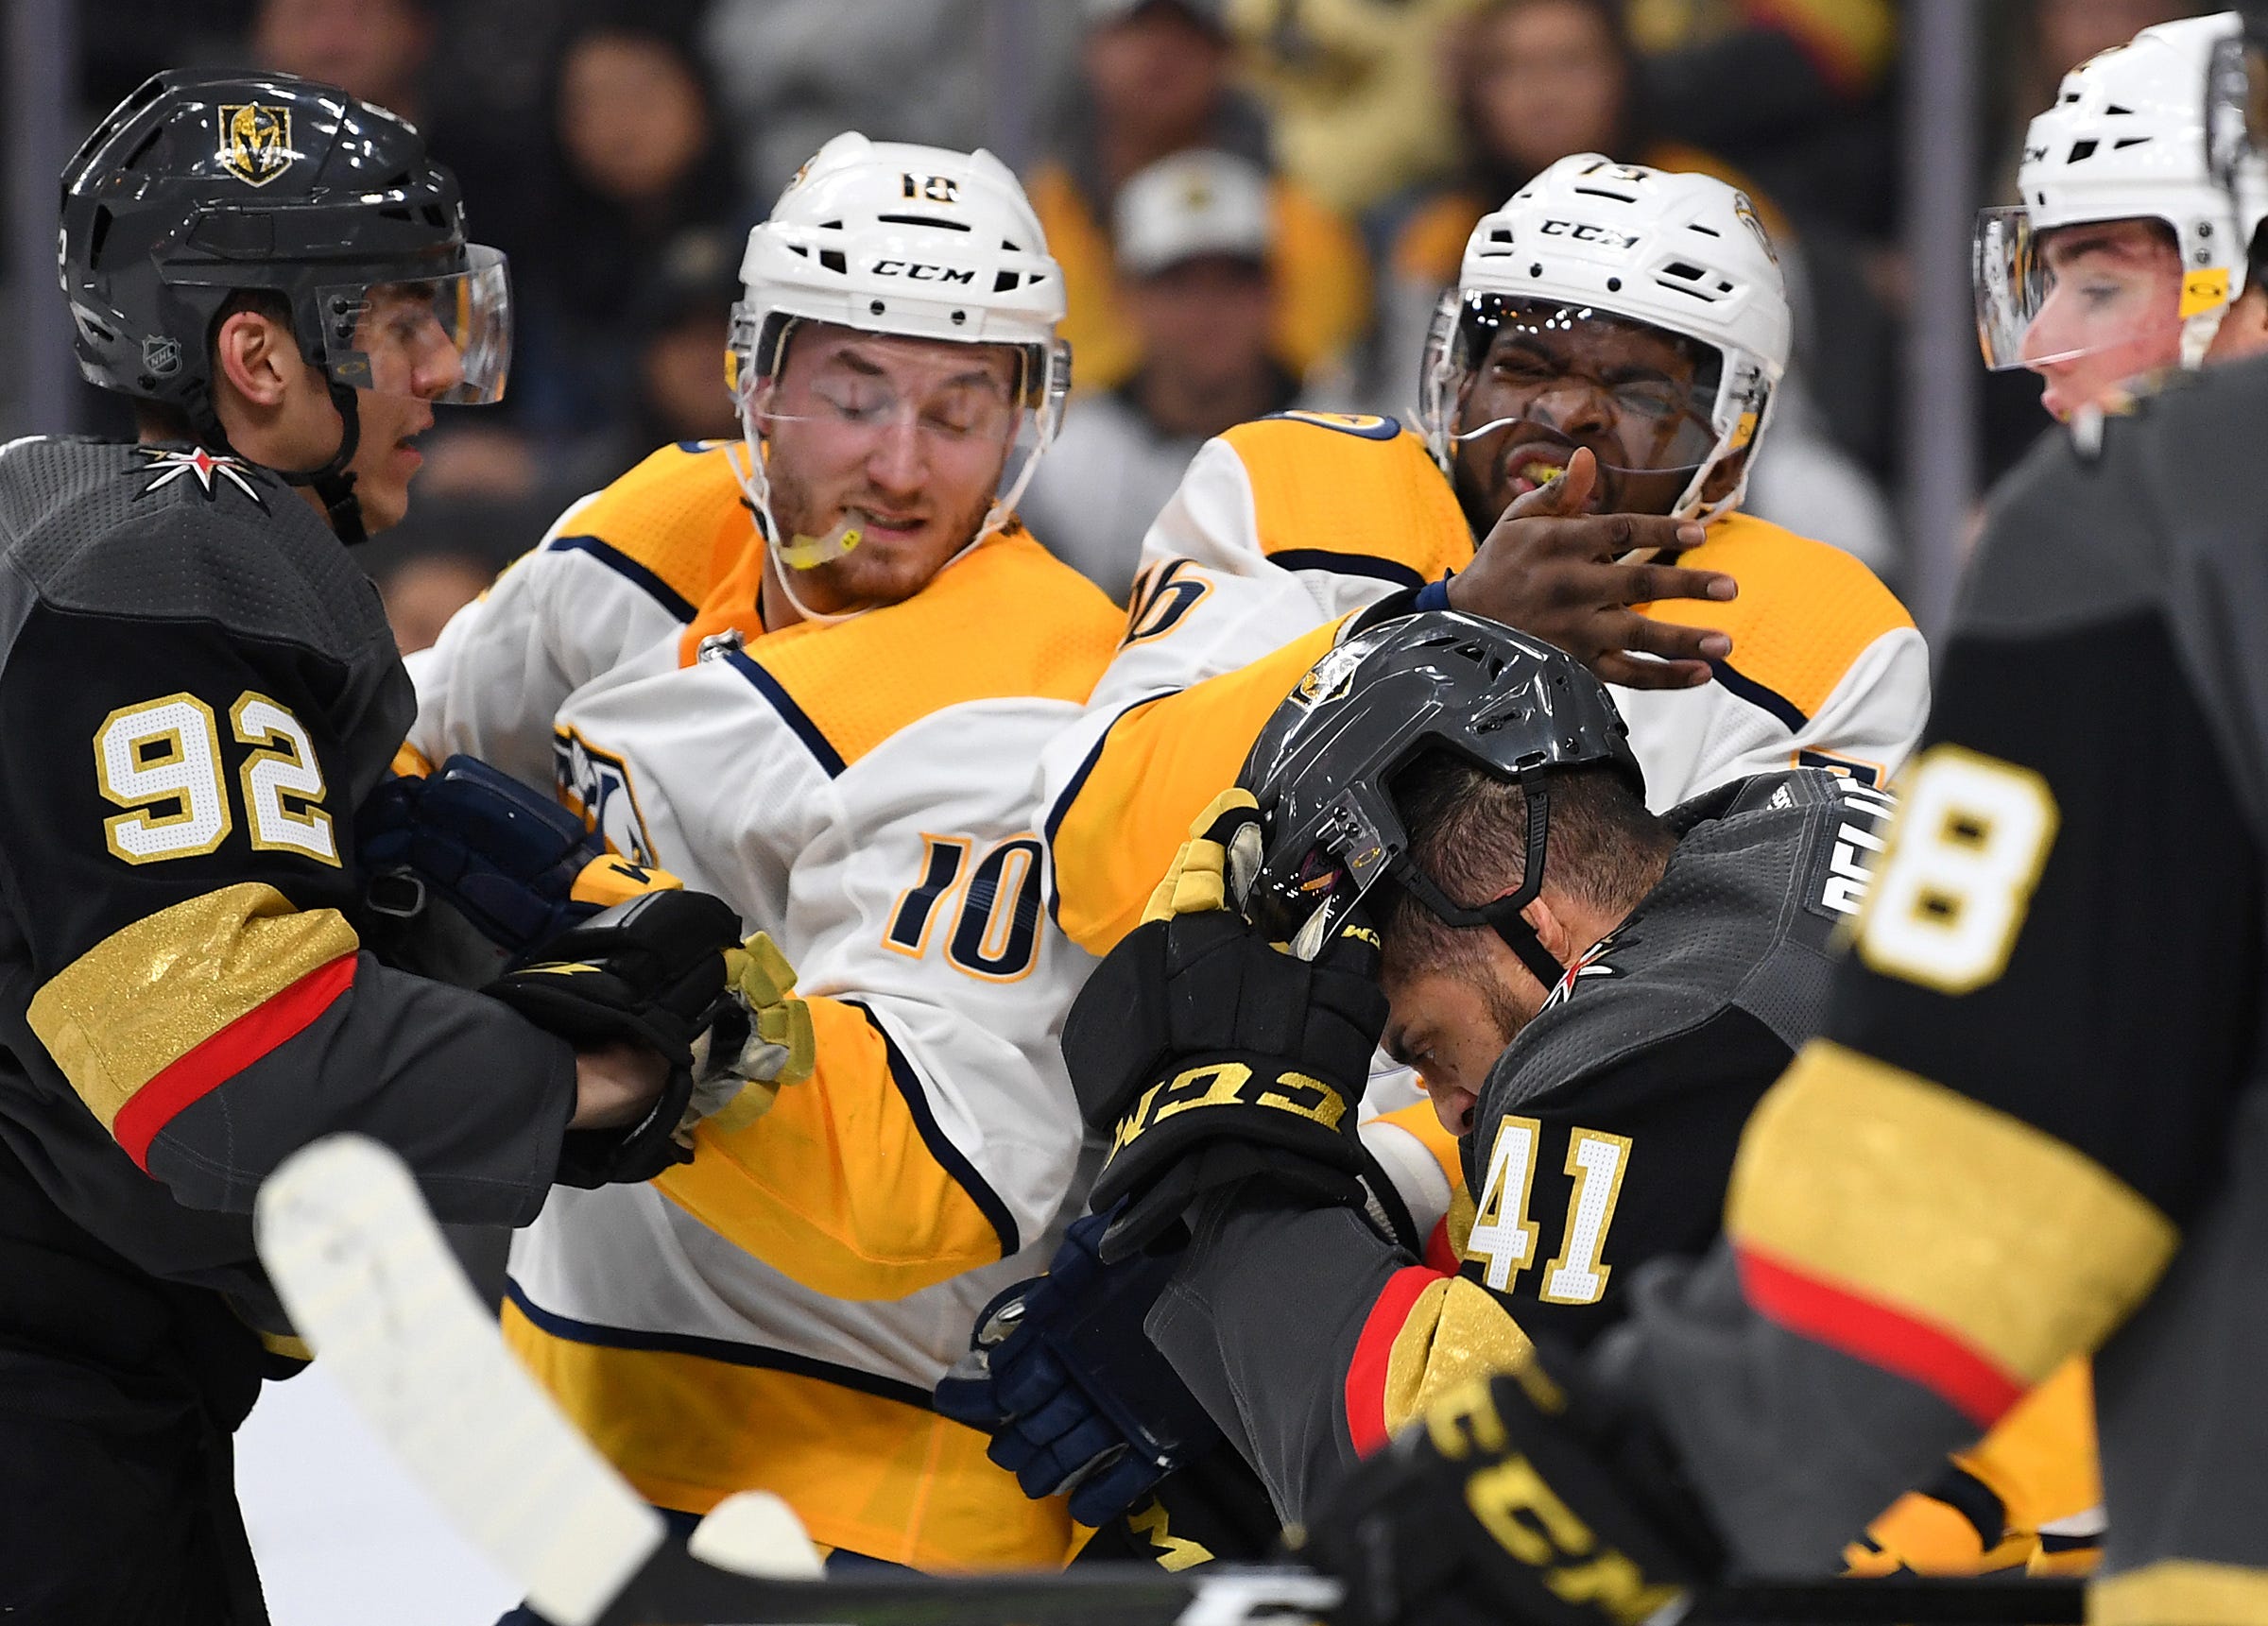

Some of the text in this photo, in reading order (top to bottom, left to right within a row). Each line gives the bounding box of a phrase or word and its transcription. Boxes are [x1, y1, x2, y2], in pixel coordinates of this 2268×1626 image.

[871, 260, 976, 285] CCM
[1539, 219, 1641, 249] CCM
[93, 690, 343, 867] 92
[881, 830, 1045, 984] 10
[1854, 741, 2062, 997] 8
[1103, 1062, 1348, 1172] CCM
[1465, 1114, 1633, 1305] 41
